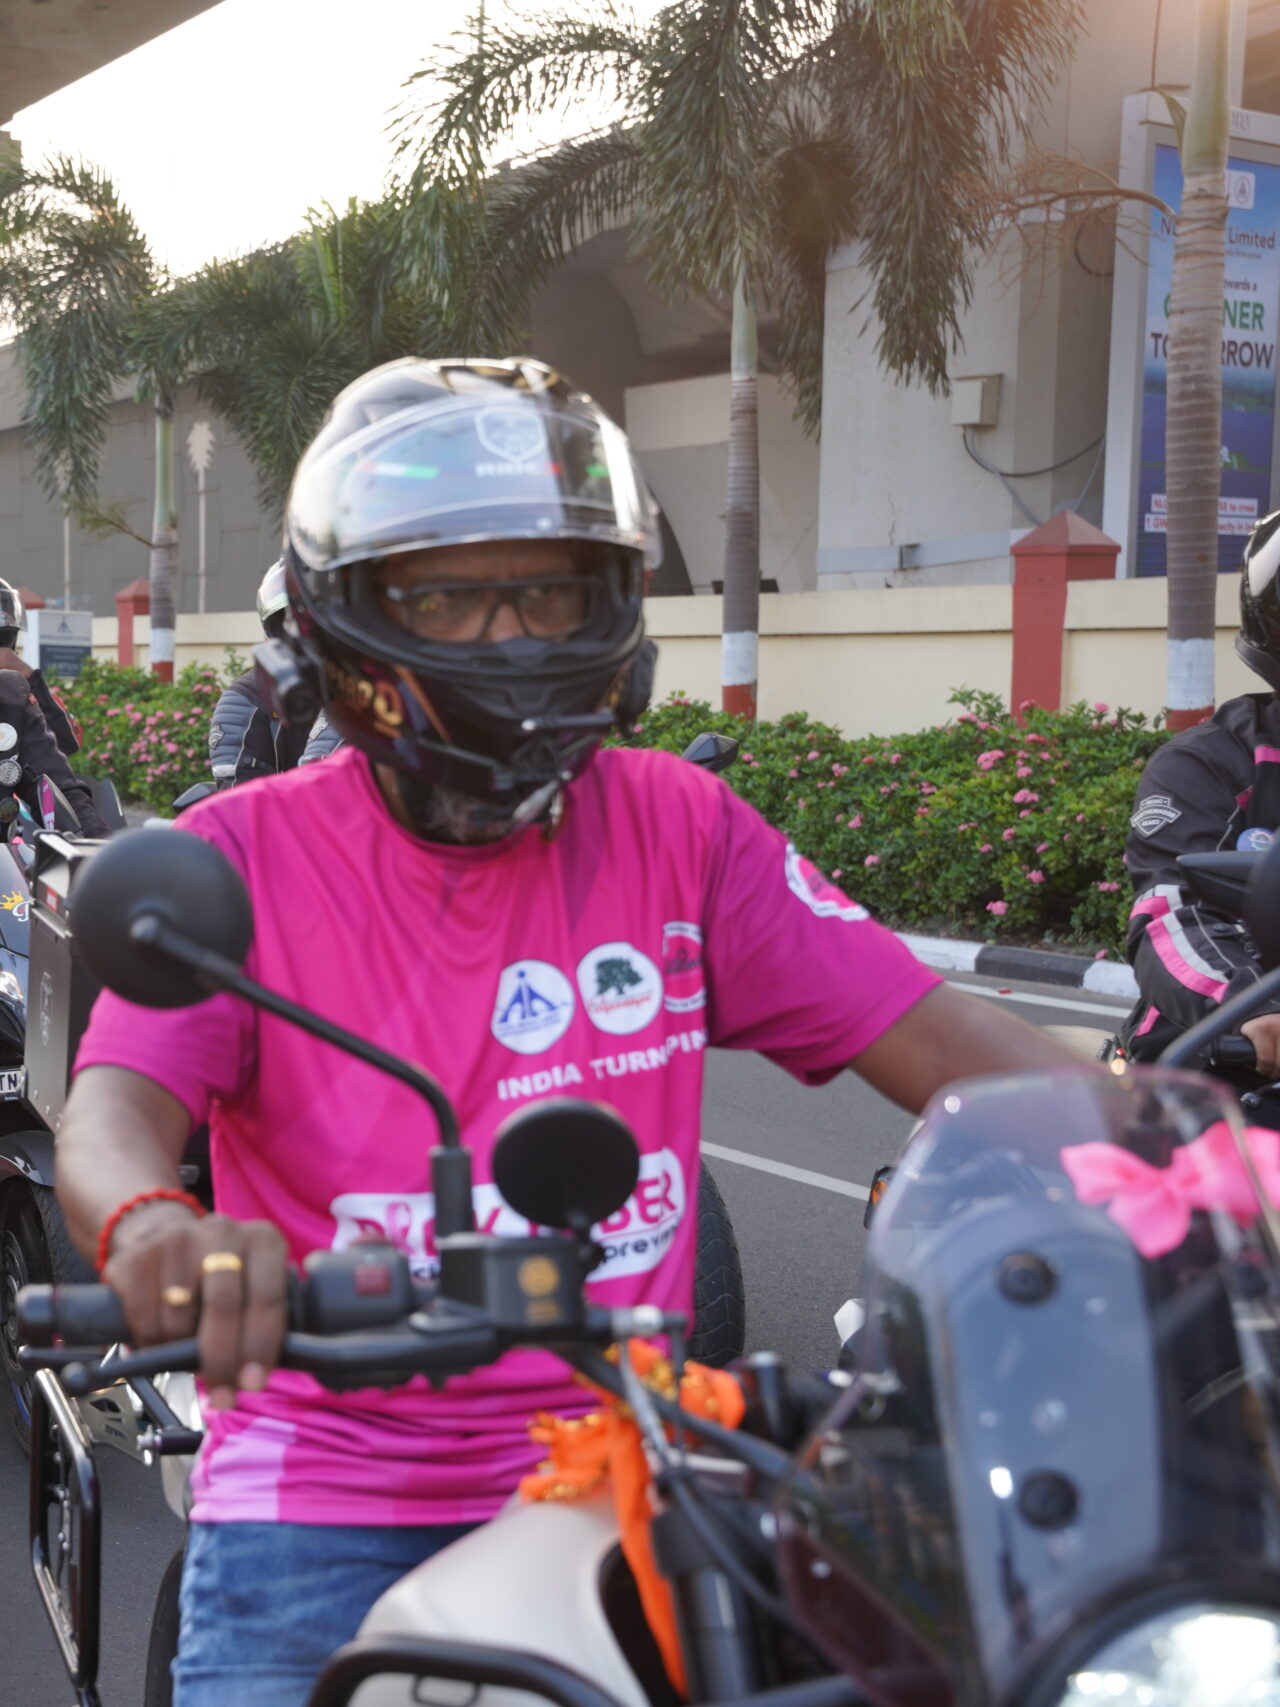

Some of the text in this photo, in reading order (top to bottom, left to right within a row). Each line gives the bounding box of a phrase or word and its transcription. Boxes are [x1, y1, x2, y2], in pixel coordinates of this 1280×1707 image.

[1228, 227, 1276, 249] Limited
[496, 1027, 708, 1101] INDIA TURN PIN
